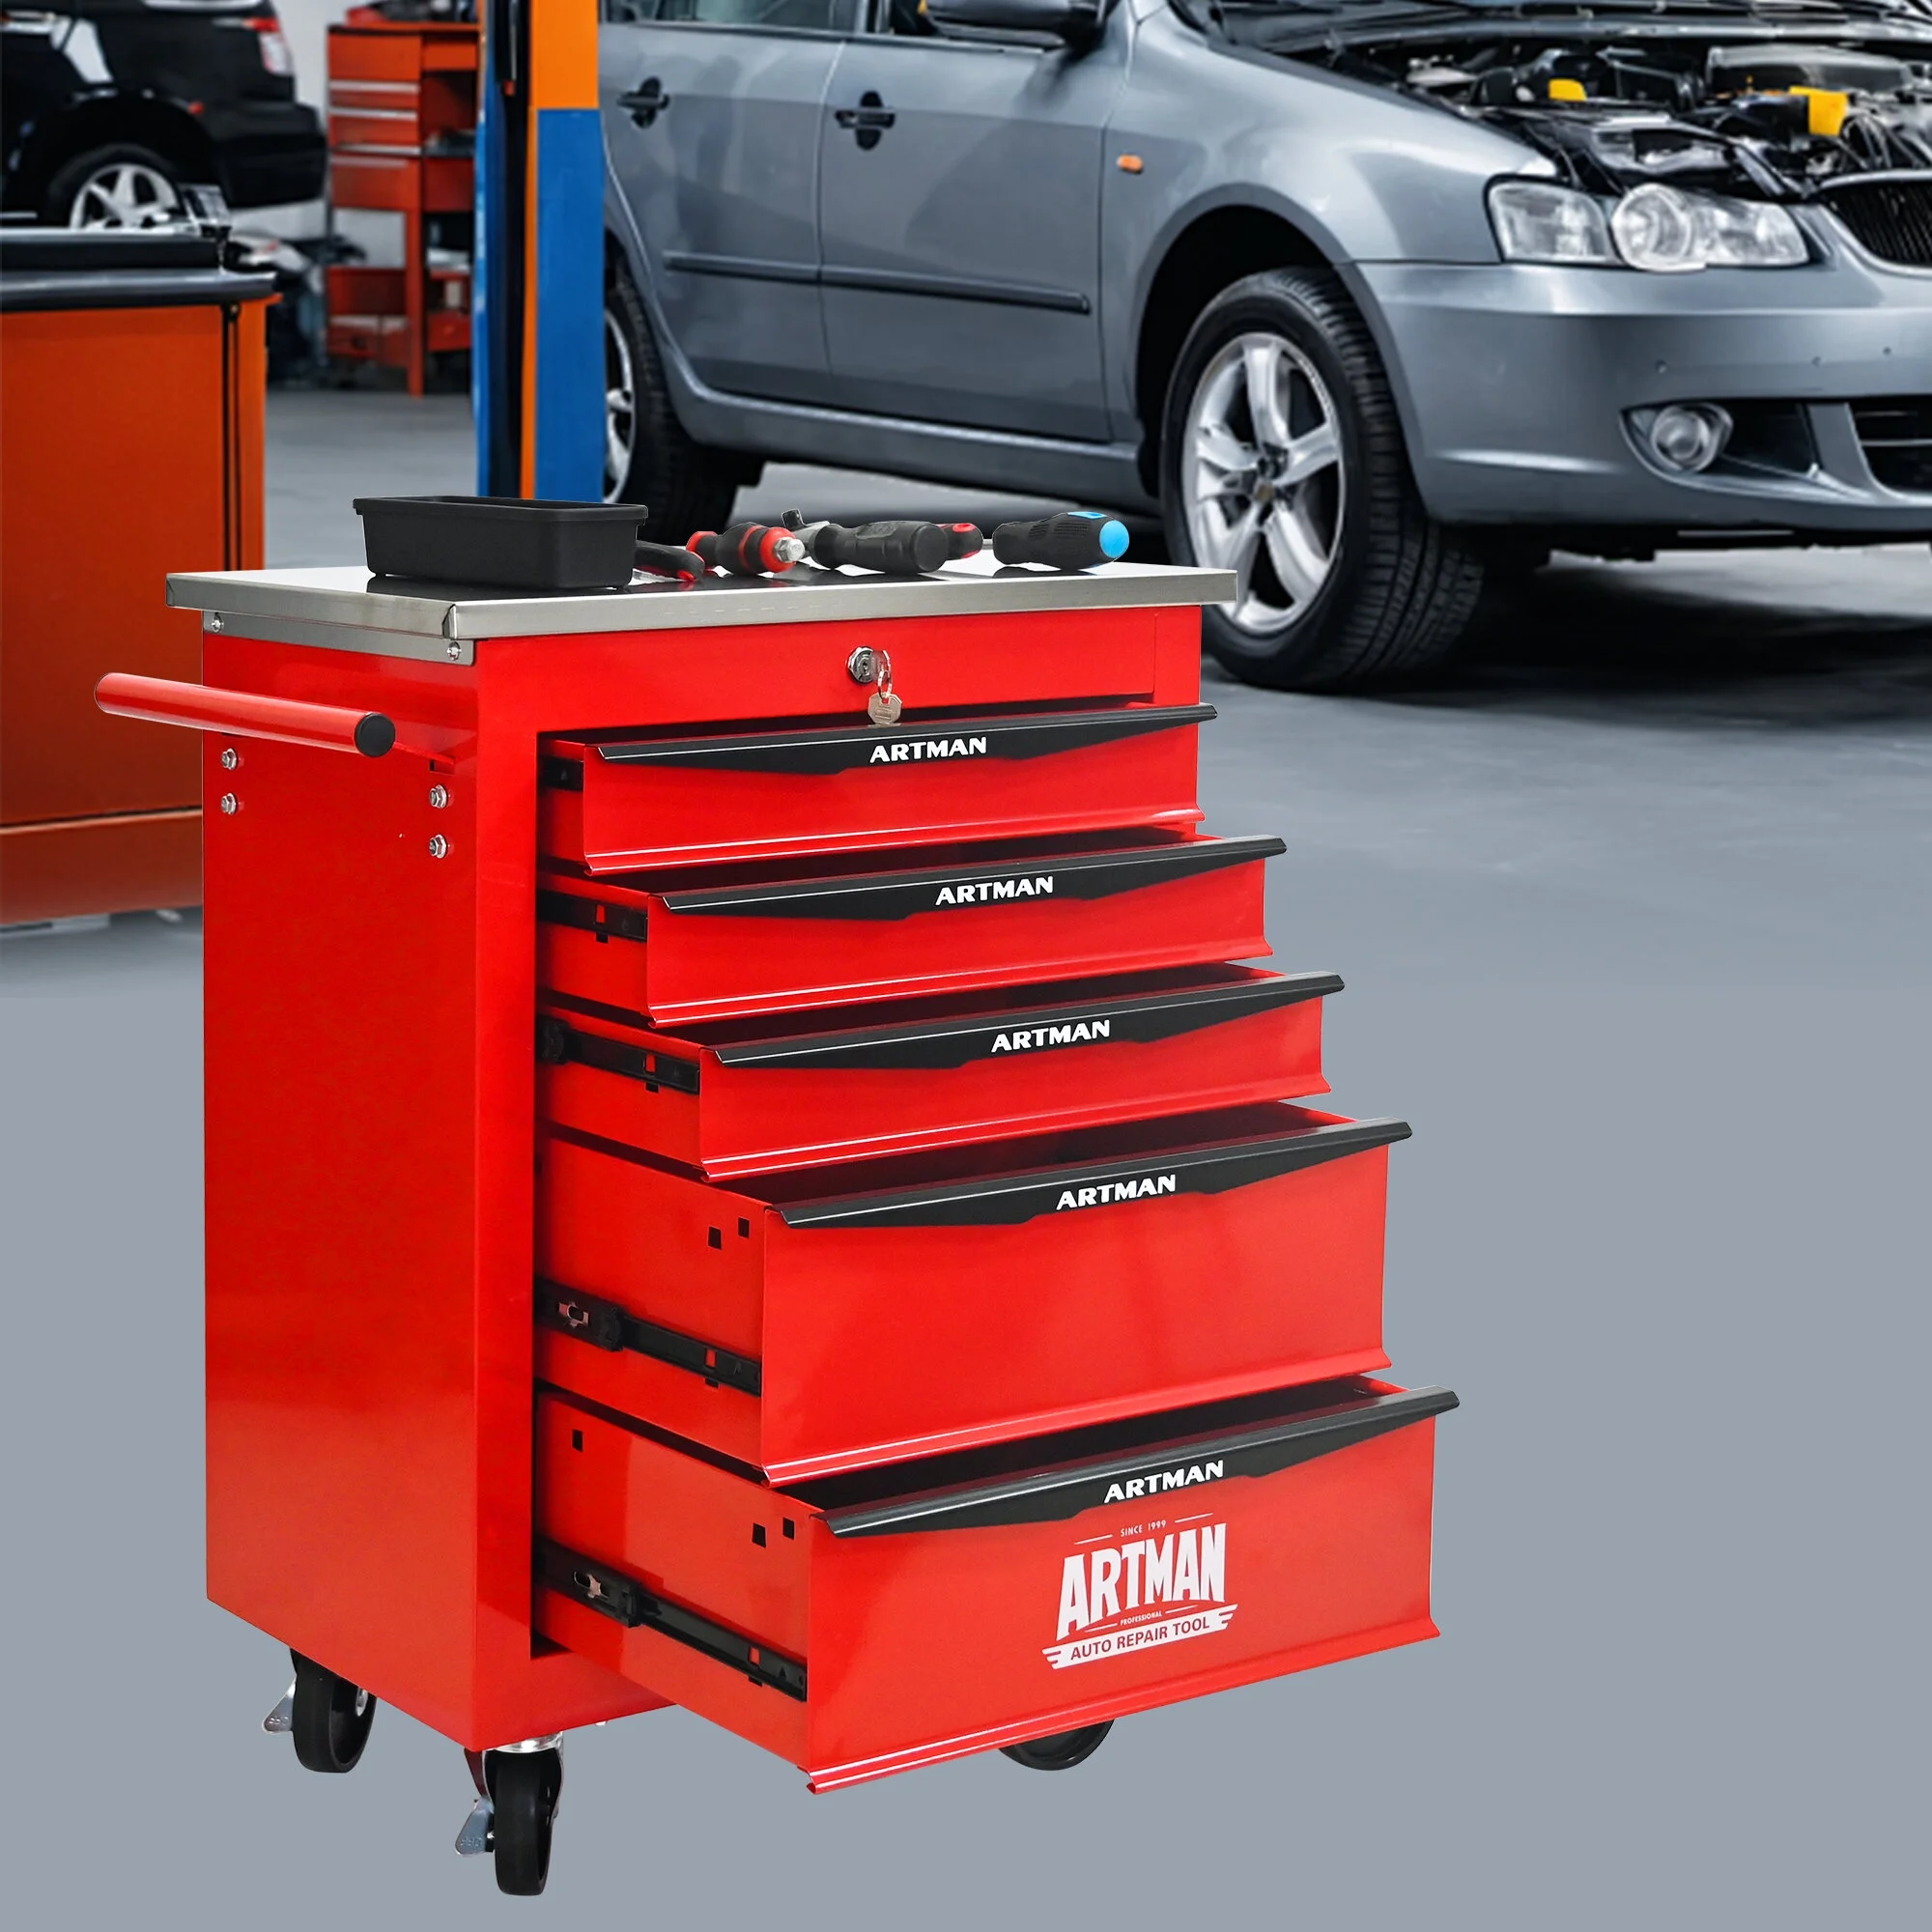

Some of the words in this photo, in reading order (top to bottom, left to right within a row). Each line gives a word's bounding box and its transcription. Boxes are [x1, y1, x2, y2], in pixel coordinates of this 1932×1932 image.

[870, 737, 986, 762] ARTMAN
[936, 876, 1053, 905] ARTMAN
[992, 1020, 1109, 1052] ARTMAN
[1057, 1175, 1175, 1209] ARTMAN
[1104, 1461, 1223, 1503] ARTMAN
[1121, 1525, 1143, 1537] SINCE
[1148, 1520, 1166, 1530] 1999
[1057, 1523, 1226, 1641] ARTMAN
[1120, 1611, 1162, 1626] PROFESSIONAL
[1071, 1639, 1111, 1660] AUTO
[1117, 1627, 1168, 1649] REPAIR
[1173, 1616, 1209, 1635] TOOL
